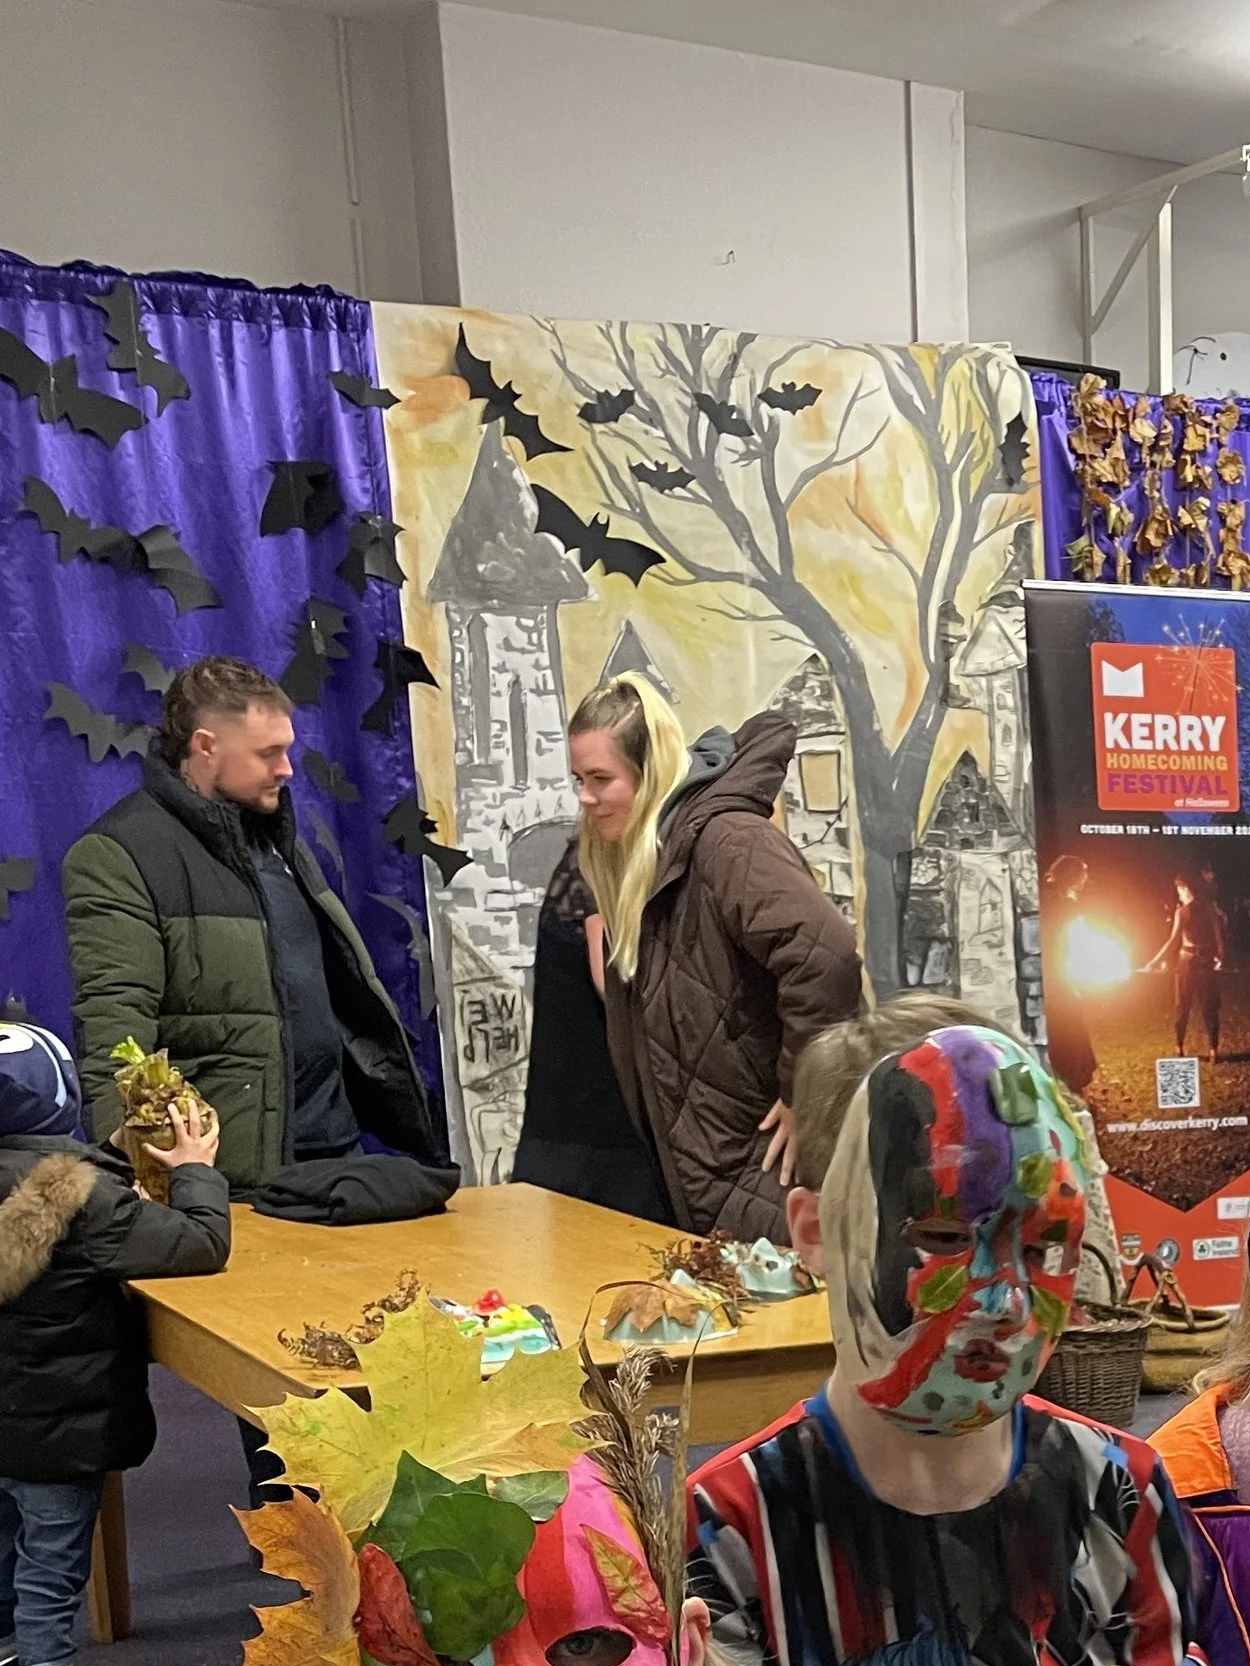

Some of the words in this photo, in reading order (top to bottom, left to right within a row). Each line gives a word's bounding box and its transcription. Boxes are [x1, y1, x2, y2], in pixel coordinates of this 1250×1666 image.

[1103, 712, 1227, 752] KERRY
[1105, 752, 1229, 771] HOMECOMING
[1107, 772, 1229, 796] FESTIVAL
[1080, 824, 1124, 835] OCTOBER
[1181, 825, 1234, 836] NOVEMBER
[1106, 1116, 1248, 1133] www.discoverkerry.com
